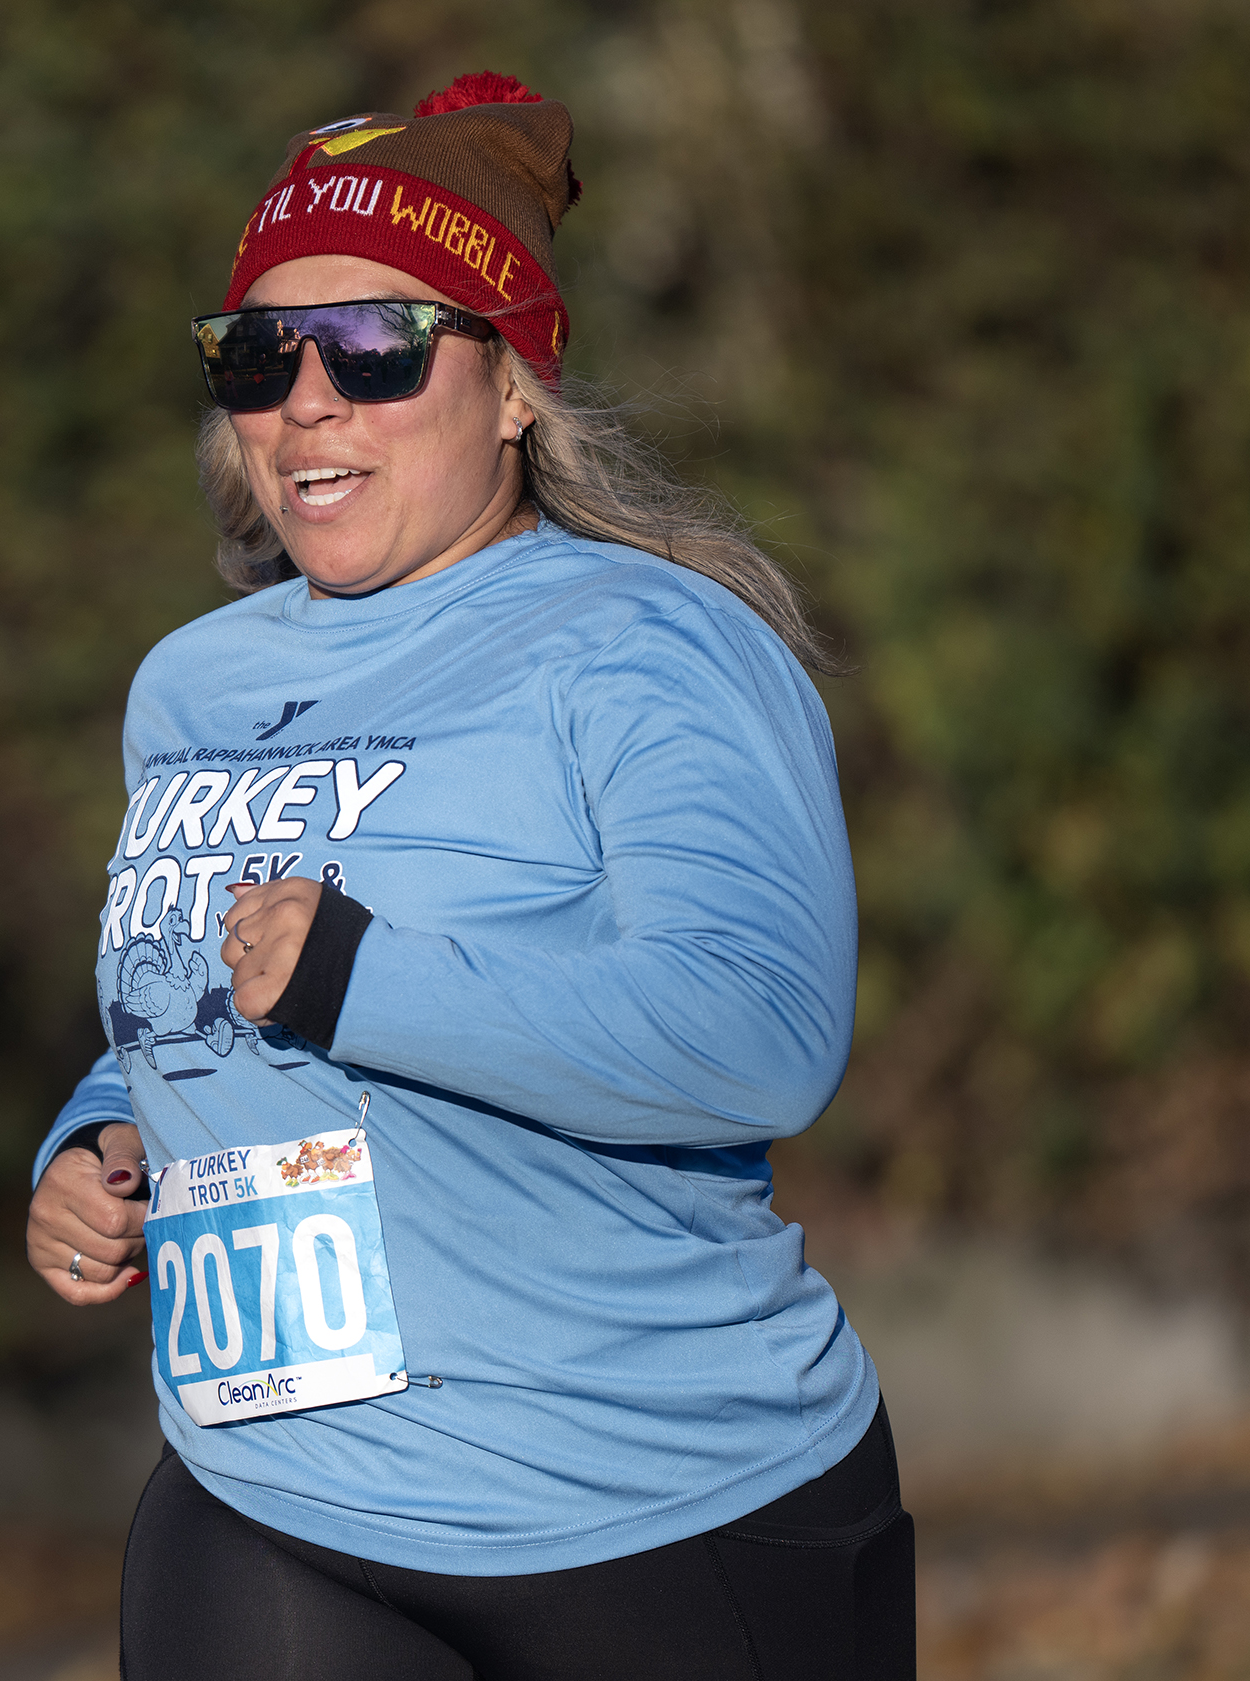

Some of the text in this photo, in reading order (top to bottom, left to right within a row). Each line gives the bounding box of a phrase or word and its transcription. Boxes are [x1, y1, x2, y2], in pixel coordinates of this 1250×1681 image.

[258, 175, 520, 302] TIL YOU WOBBLE
[252, 720, 271, 730] the
[190, 741, 321, 763] RAPPAHANNOCK
[314, 735, 362, 754] AREA
[364, 736, 417, 751] YMCA
[320, 860, 347, 896] &
[188, 1150, 251, 1179] TURKEY
[188, 1181, 230, 1206] TROT
[235, 1175, 258, 1198] 5K
[156, 1213, 367, 1377] 2070
[217, 1373, 296, 1406] CleanArc
[255, 1397, 298, 1409] DATA CENTERS
